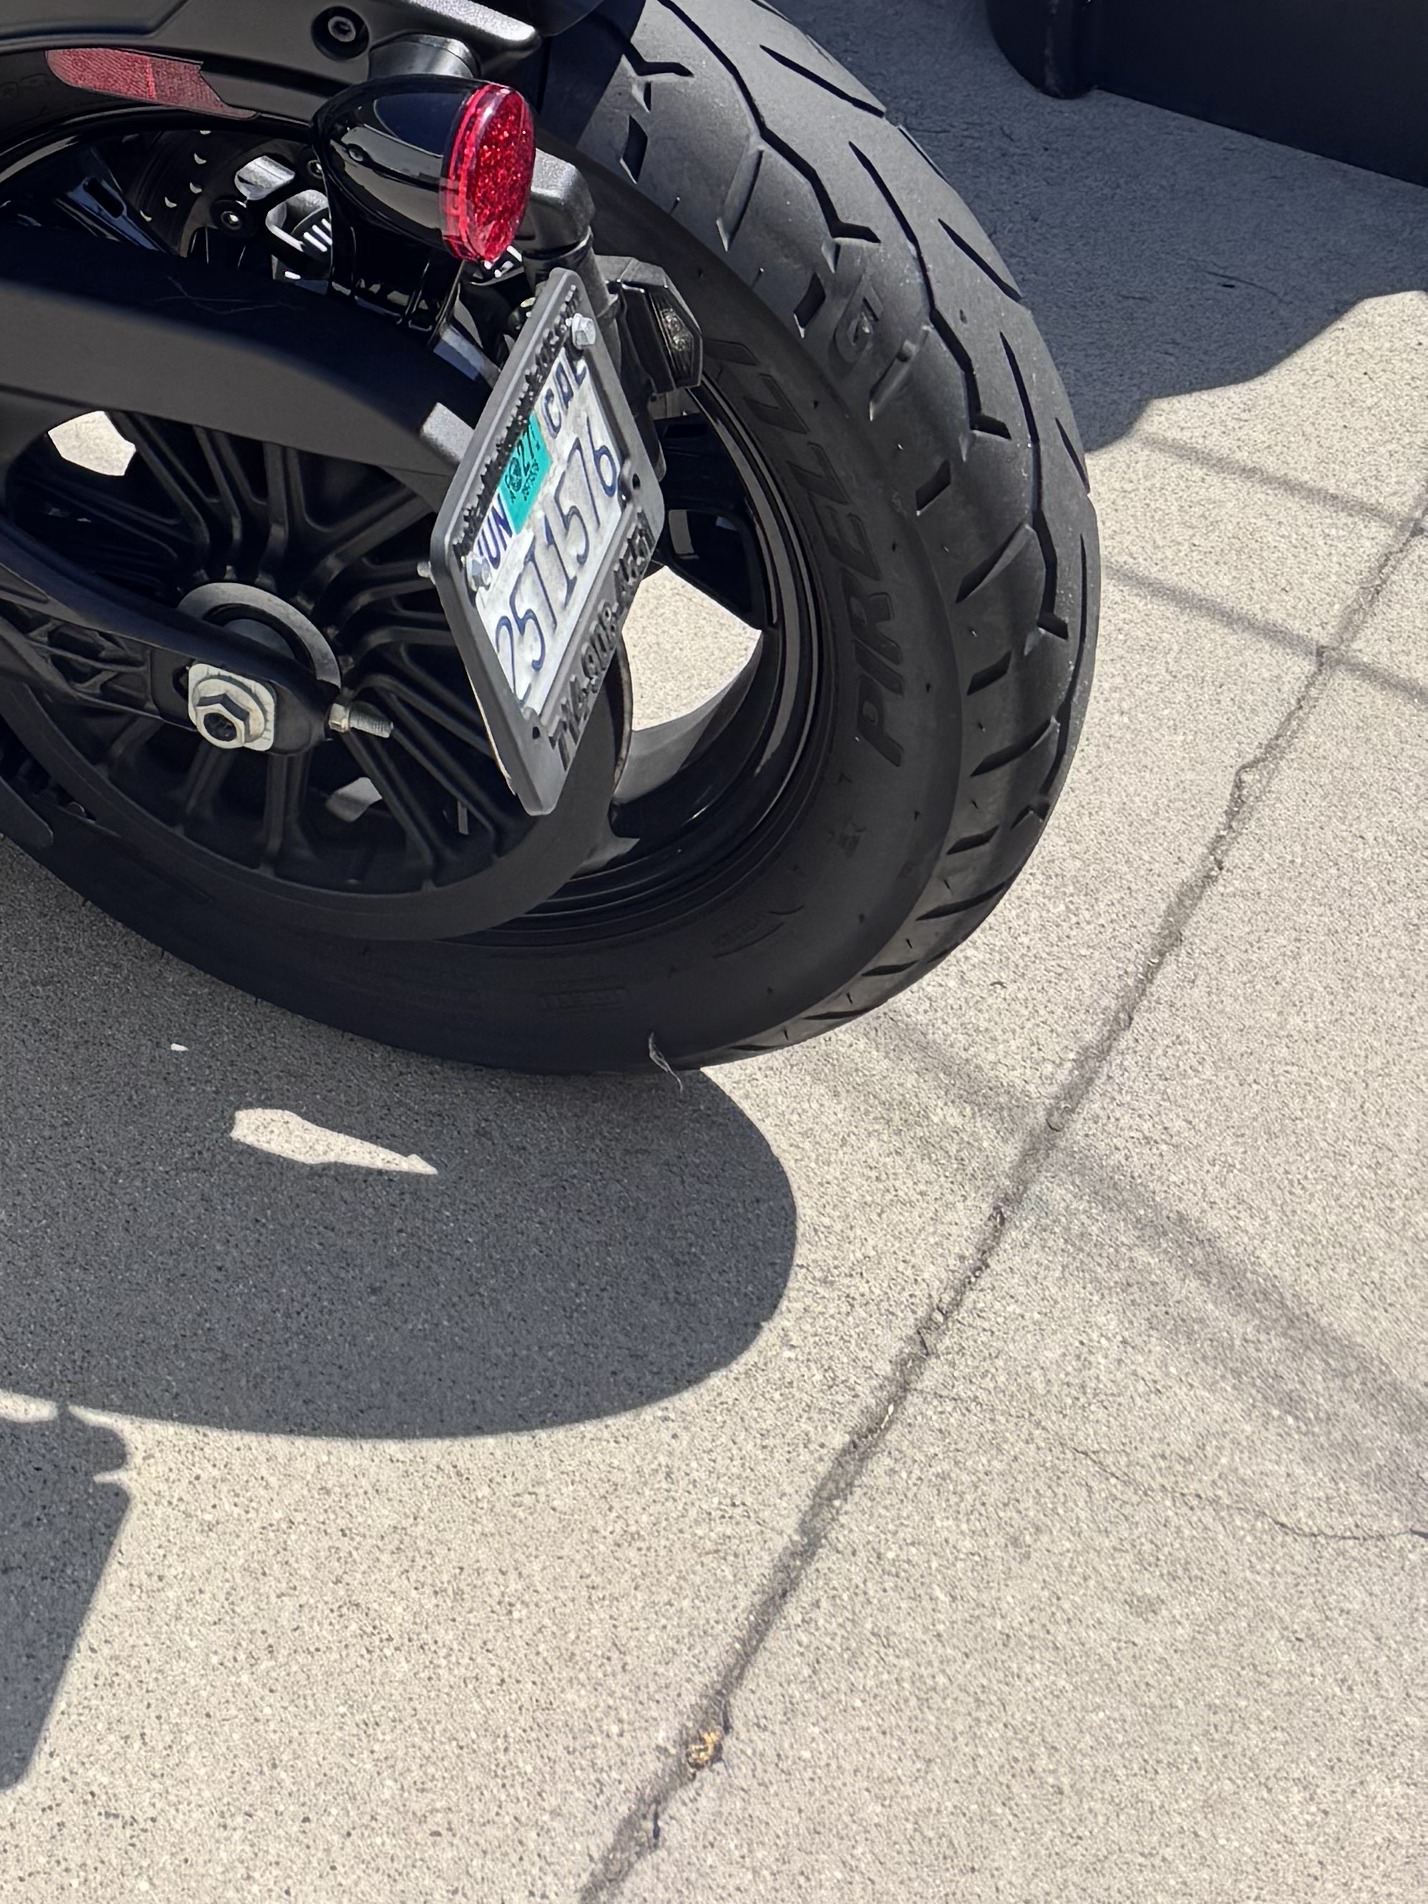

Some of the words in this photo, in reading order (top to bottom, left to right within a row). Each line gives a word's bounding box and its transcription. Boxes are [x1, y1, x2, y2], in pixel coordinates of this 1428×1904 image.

[478, 490, 512, 569] UN
[495, 432, 617, 708] 25T1576
[698, 337, 905, 765] PIRELLI
